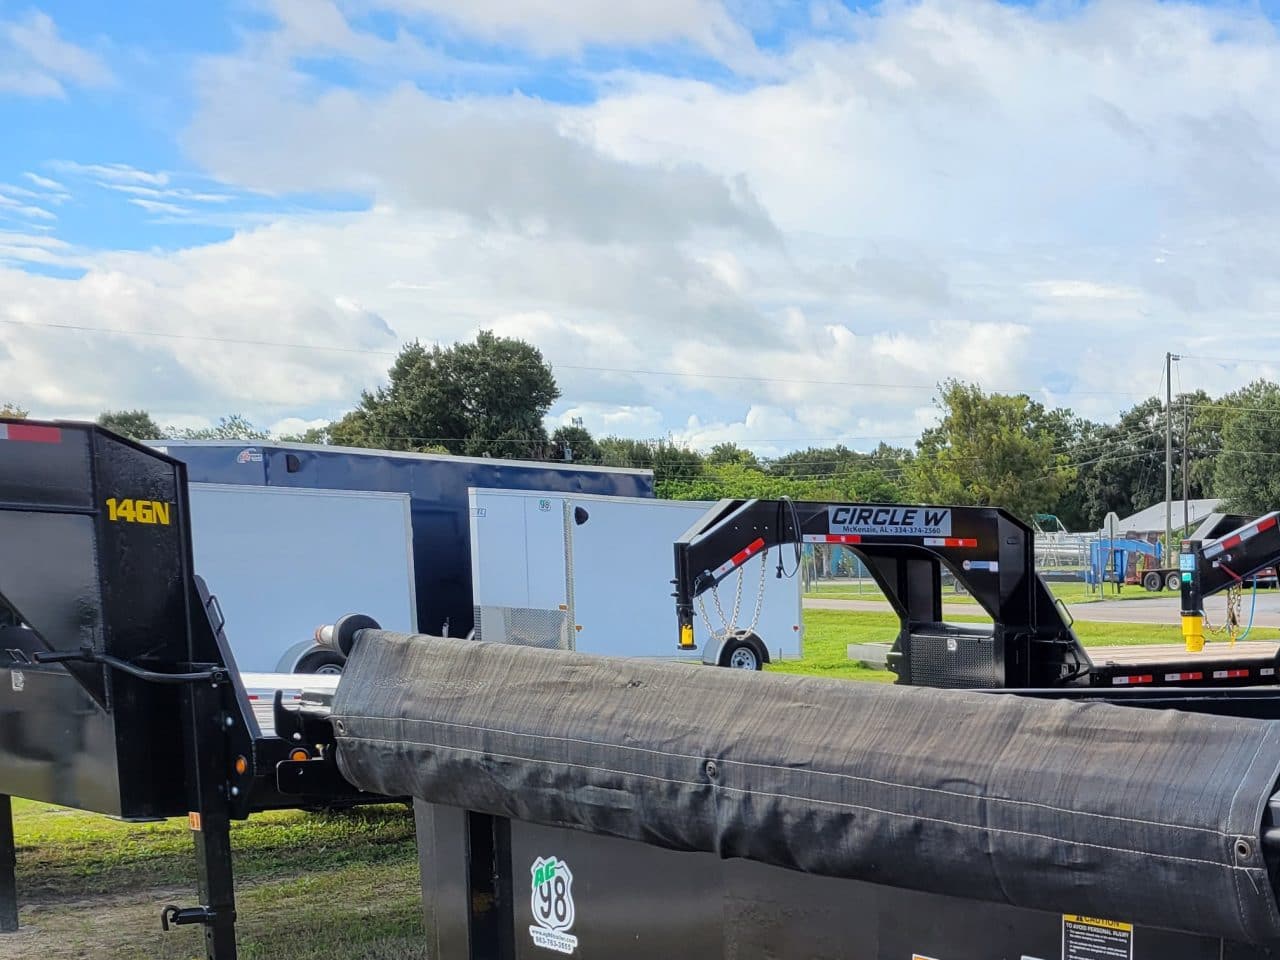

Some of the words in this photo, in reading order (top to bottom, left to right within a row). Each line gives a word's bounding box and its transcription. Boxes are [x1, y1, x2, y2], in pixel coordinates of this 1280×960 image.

[106, 498, 170, 525] 14GN
[831, 507, 918, 526] CIRCLE
[924, 509, 949, 527] W
[842, 526, 878, 534] McKenzie,
[534, 860, 556, 888] AG
[539, 875, 567, 922] 98
